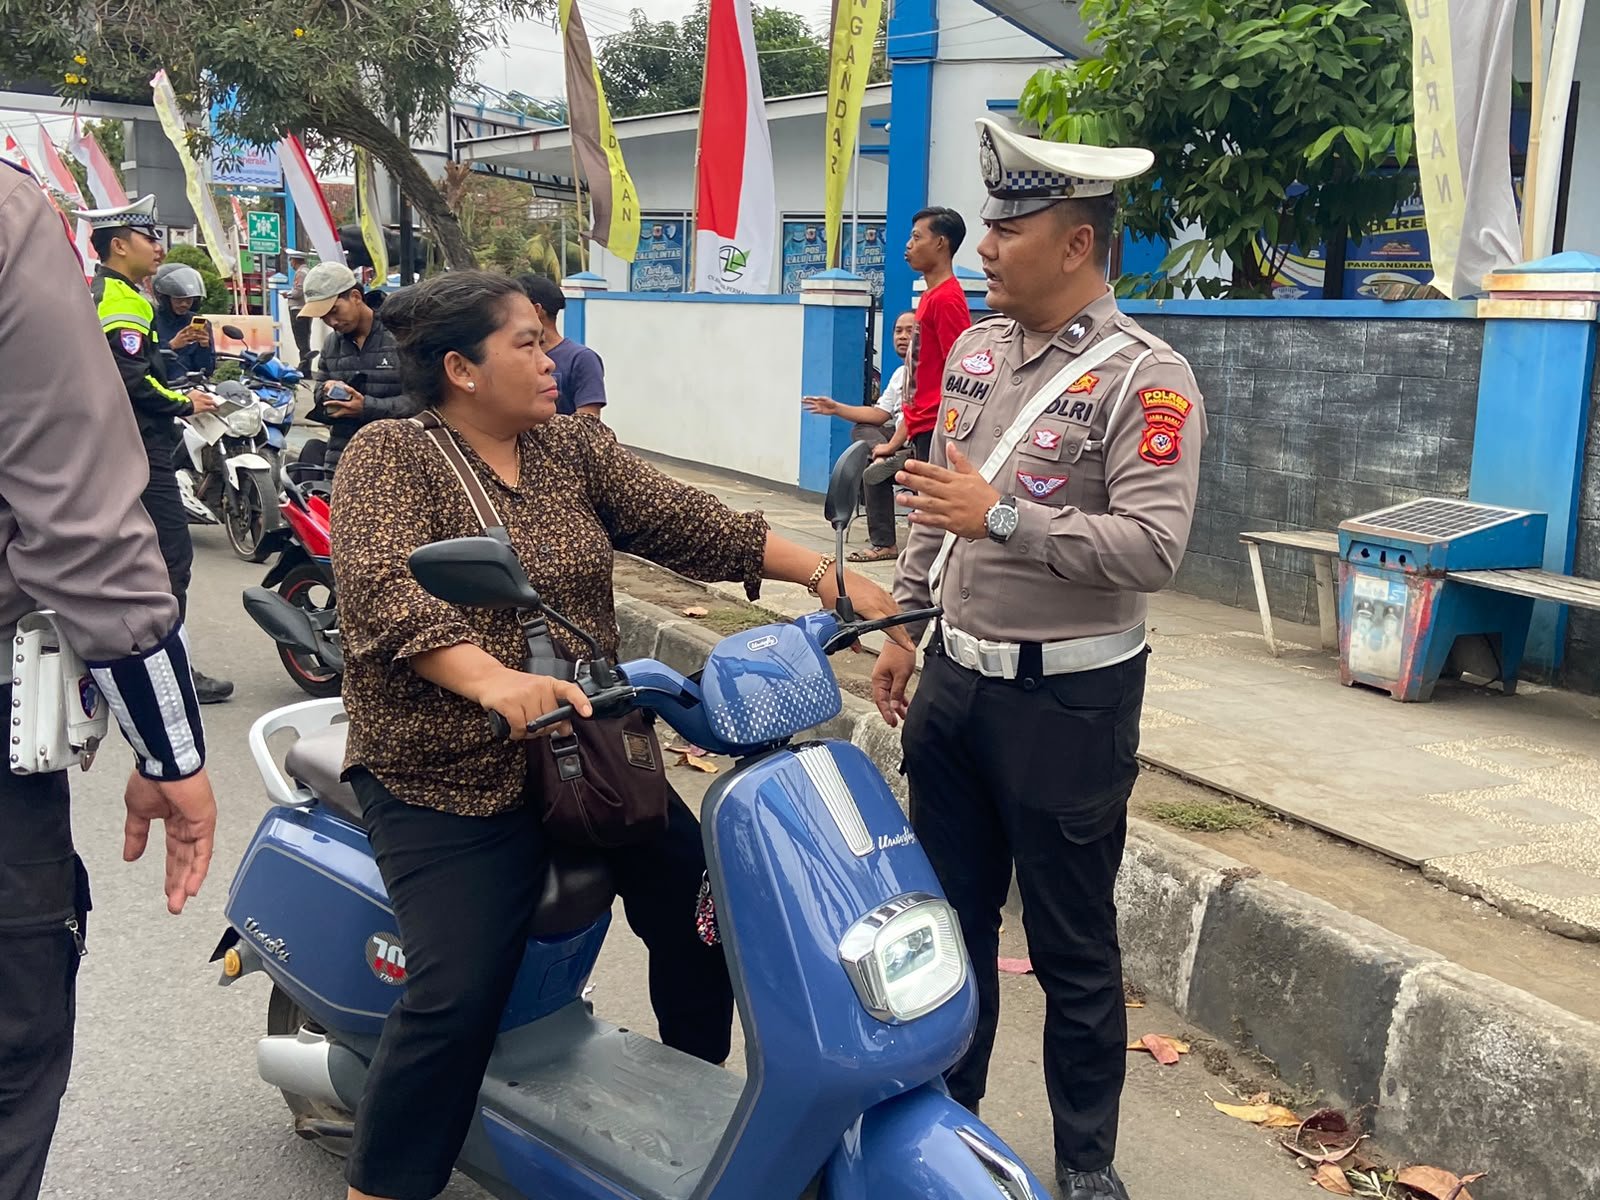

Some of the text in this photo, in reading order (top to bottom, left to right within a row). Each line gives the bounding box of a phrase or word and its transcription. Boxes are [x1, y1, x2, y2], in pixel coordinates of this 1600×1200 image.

[1366, 216, 1427, 234] OLRE
[805, 246, 820, 254] POS
[864, 247, 881, 255] POS
[1347, 261, 1433, 270] PANGANDARAN
[946, 374, 990, 400] GALIH
[1045, 398, 1094, 422] OLRI
